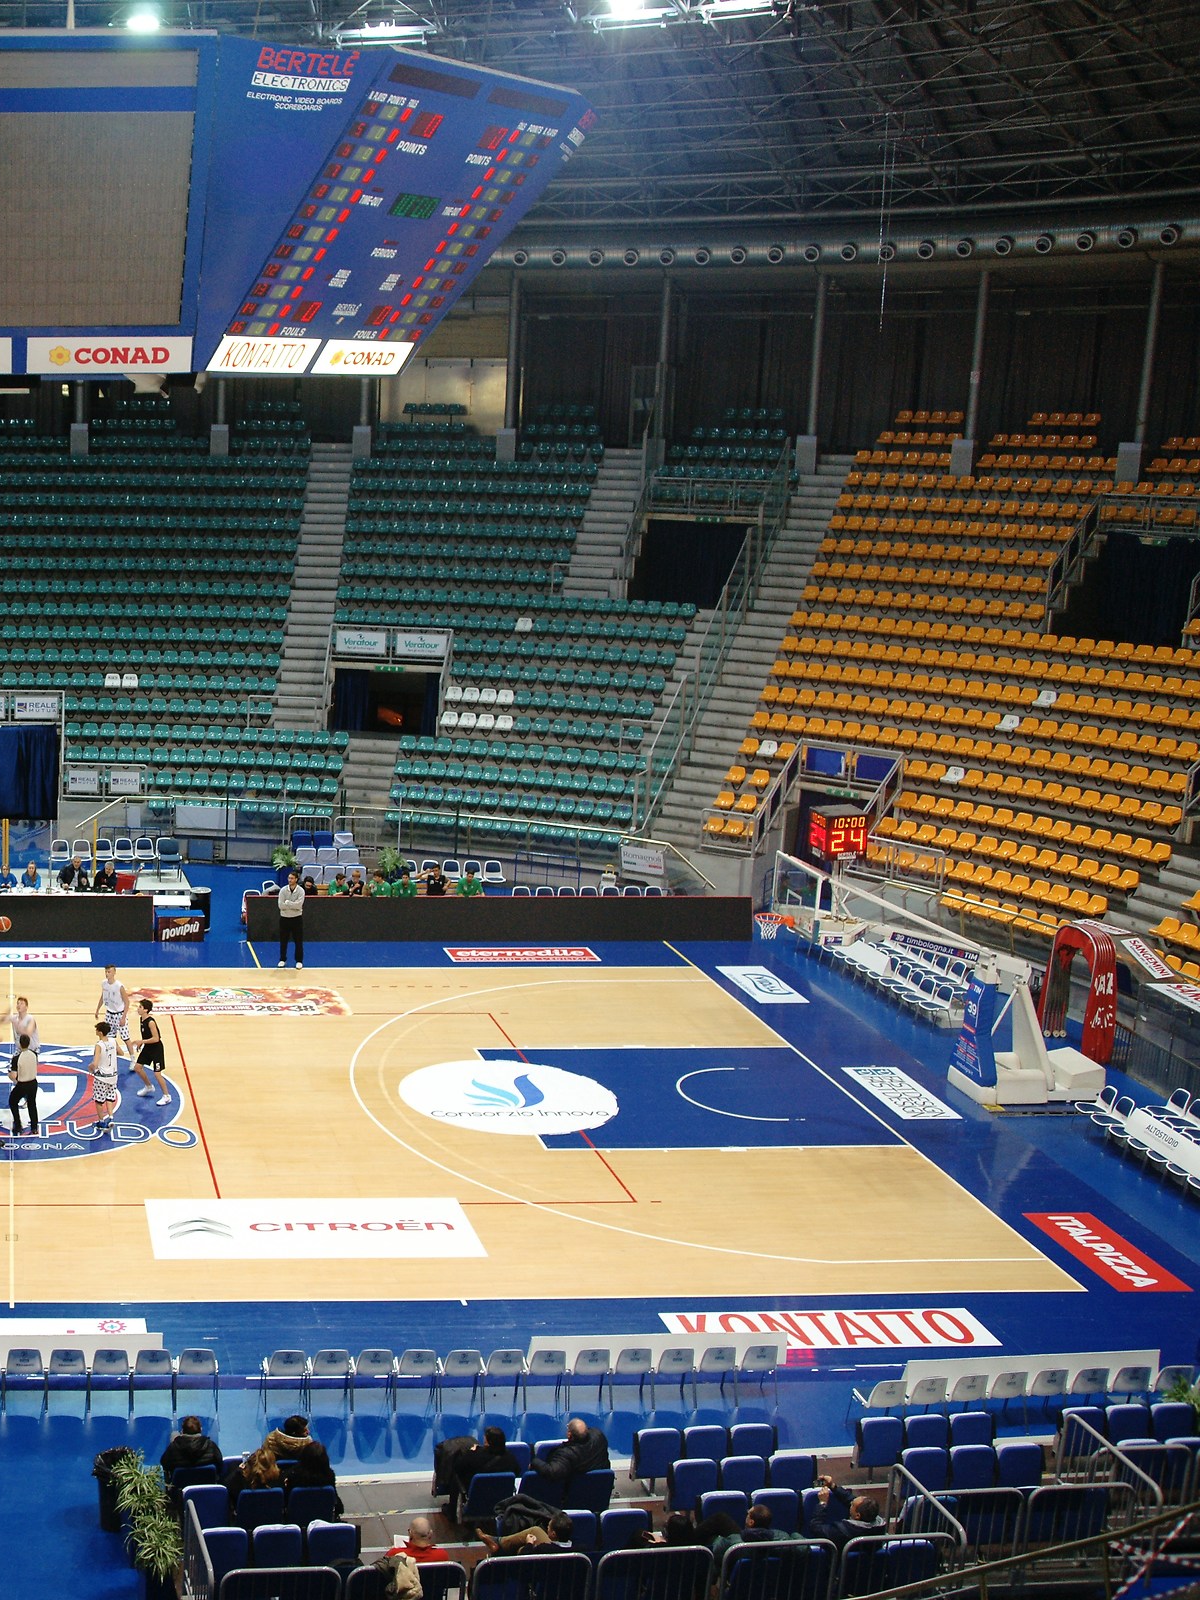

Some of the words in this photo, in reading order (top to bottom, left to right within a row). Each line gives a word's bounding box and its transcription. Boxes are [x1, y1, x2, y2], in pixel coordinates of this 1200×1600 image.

[253, 72, 348, 91] ELECTRONICS
[246, 92, 292, 102] ELECTRONIC
[396, 140, 428, 155] POINTS
[465, 153, 492, 166] POINTS
[280, 326, 307, 336] FOULS
[353, 330, 378, 340] FOULS
[74, 346, 170, 364] CONAD
[220, 342, 306, 368] KONTATTO
[343, 351, 395, 366] CONAD
[344, 638, 378, 646] Veratour
[404, 640, 439, 649] Veratour
[834, 816, 866, 828] 10:00
[832, 830, 864, 852] 24
[906, 938, 954, 954] timbologna.it
[964, 952, 978, 961] TIM
[1129, 939, 1170, 976] SANGEMINI
[968, 1001, 976, 1016] 39
[431, 1110, 534, 1118] Consorzio
[538, 1109, 610, 1117] Innova
[1146, 1124, 1178, 1148] ALTOSTUDIO
[250, 1220, 454, 1232] CITROËN
[1048, 1216, 1158, 1288] ITALPIZZA
